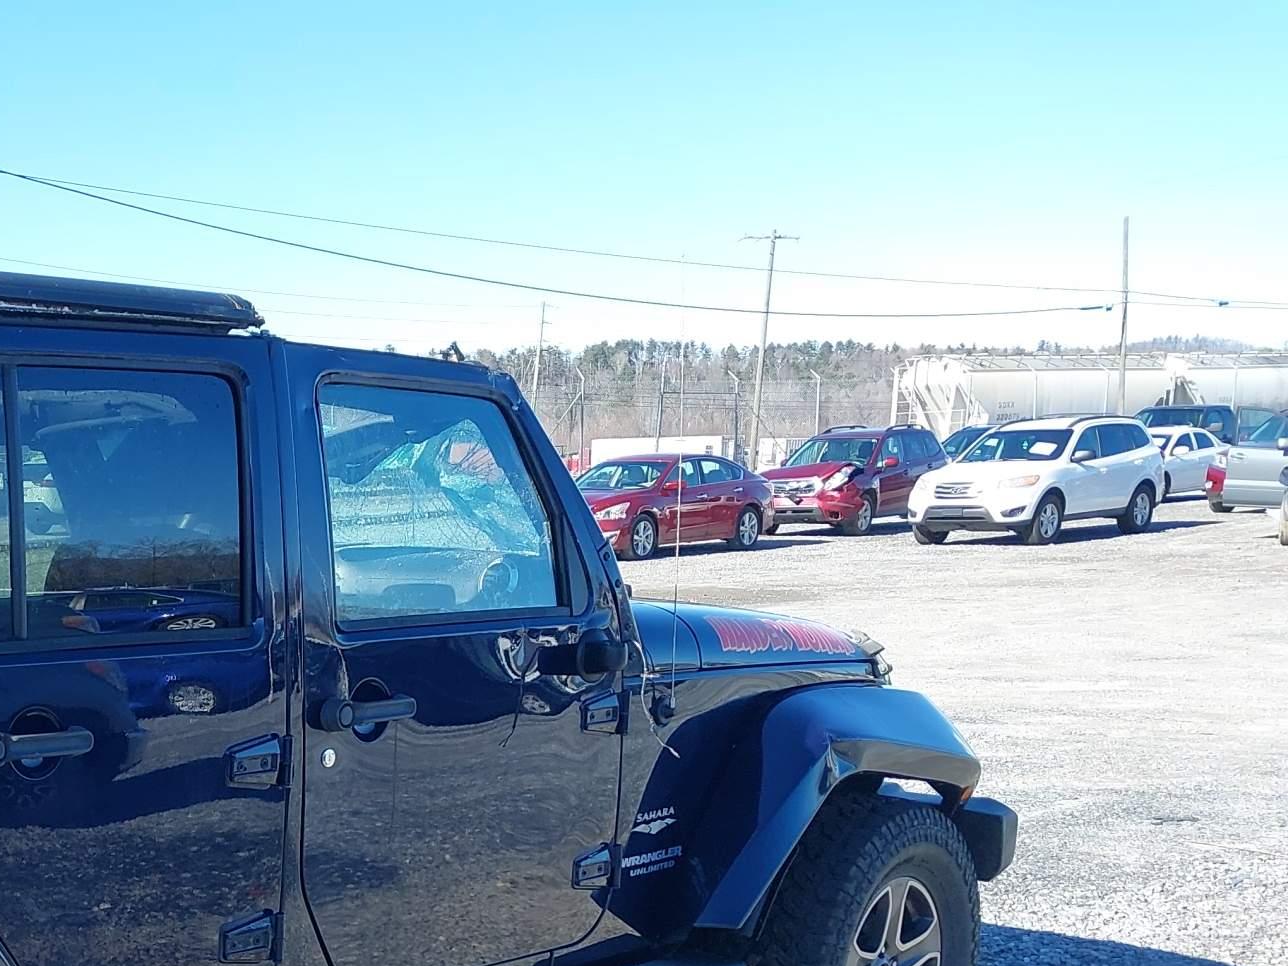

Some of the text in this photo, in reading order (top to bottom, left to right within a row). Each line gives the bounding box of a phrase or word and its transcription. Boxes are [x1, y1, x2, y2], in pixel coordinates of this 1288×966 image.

[636, 806, 675, 823] SAHARA
[621, 845, 682, 868] WRANGLER
[629, 859, 675, 877] UNLIMITED
